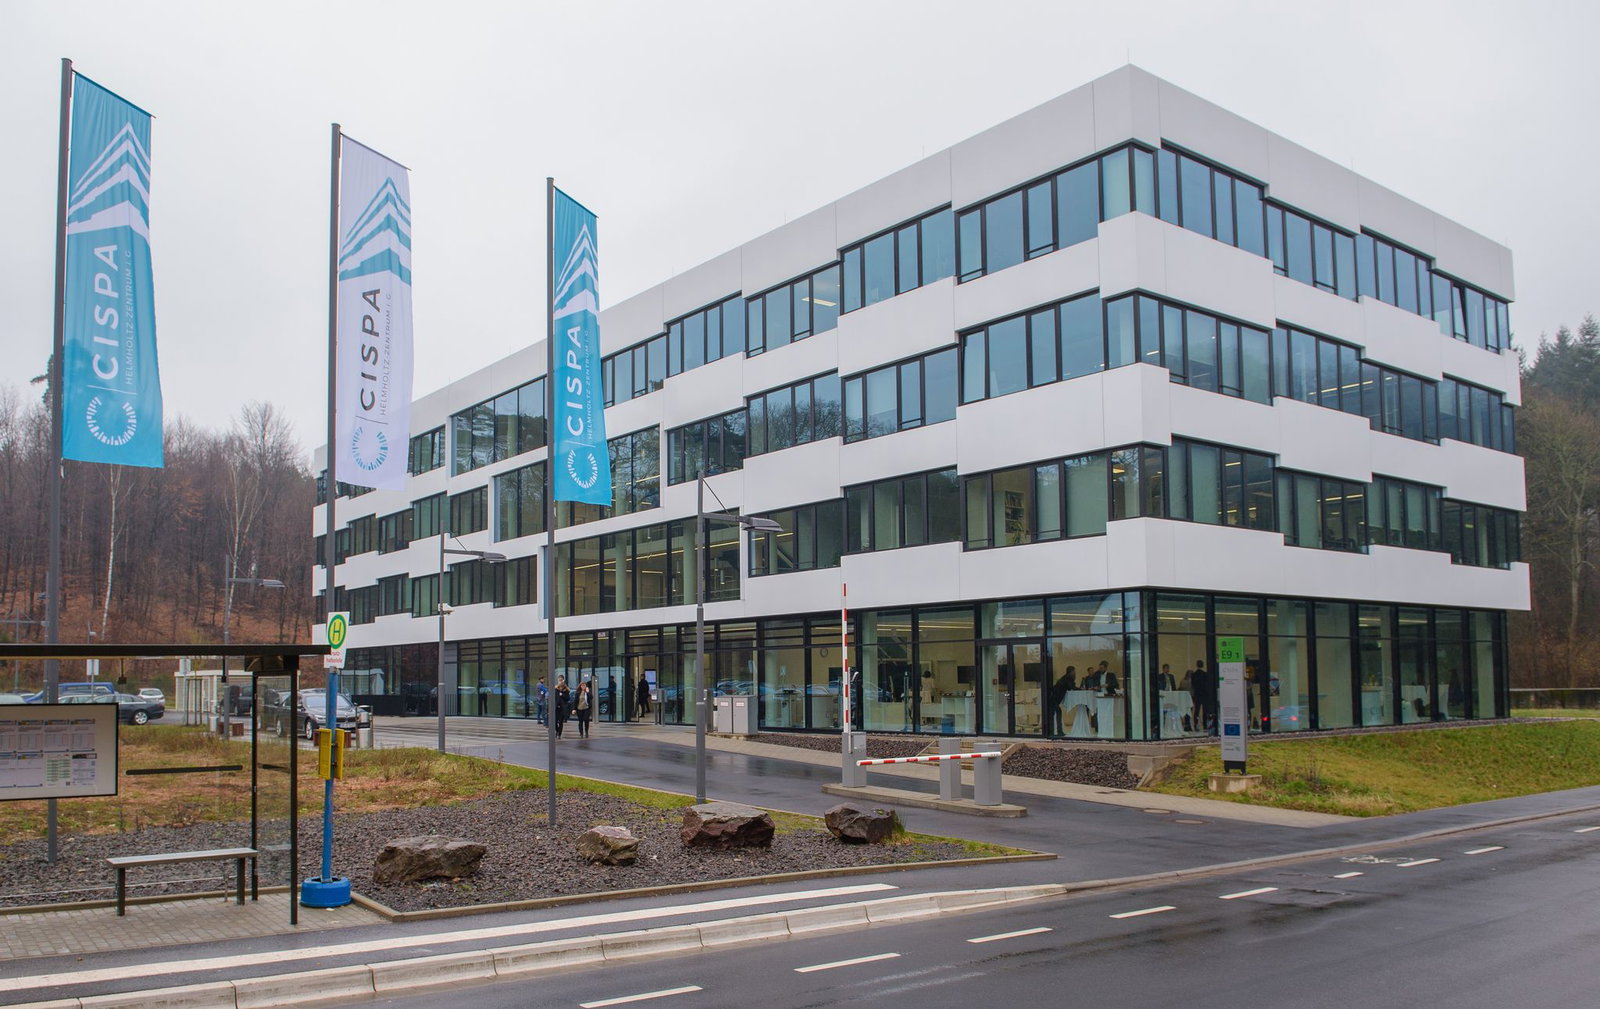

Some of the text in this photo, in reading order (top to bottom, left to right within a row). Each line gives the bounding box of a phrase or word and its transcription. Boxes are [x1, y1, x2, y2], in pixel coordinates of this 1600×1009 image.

[92, 244, 119, 380] CISPA
[124, 268, 135, 386] HELMHOLTZ-ZENTRUM
[360, 288, 381, 411] CISPA
[380, 311, 392, 416] HELMHOLTZ-ZENTRUM
[566, 325, 584, 436] CISPA
[332, 621, 342, 641] H
[1221, 650, 1232, 659] E9
